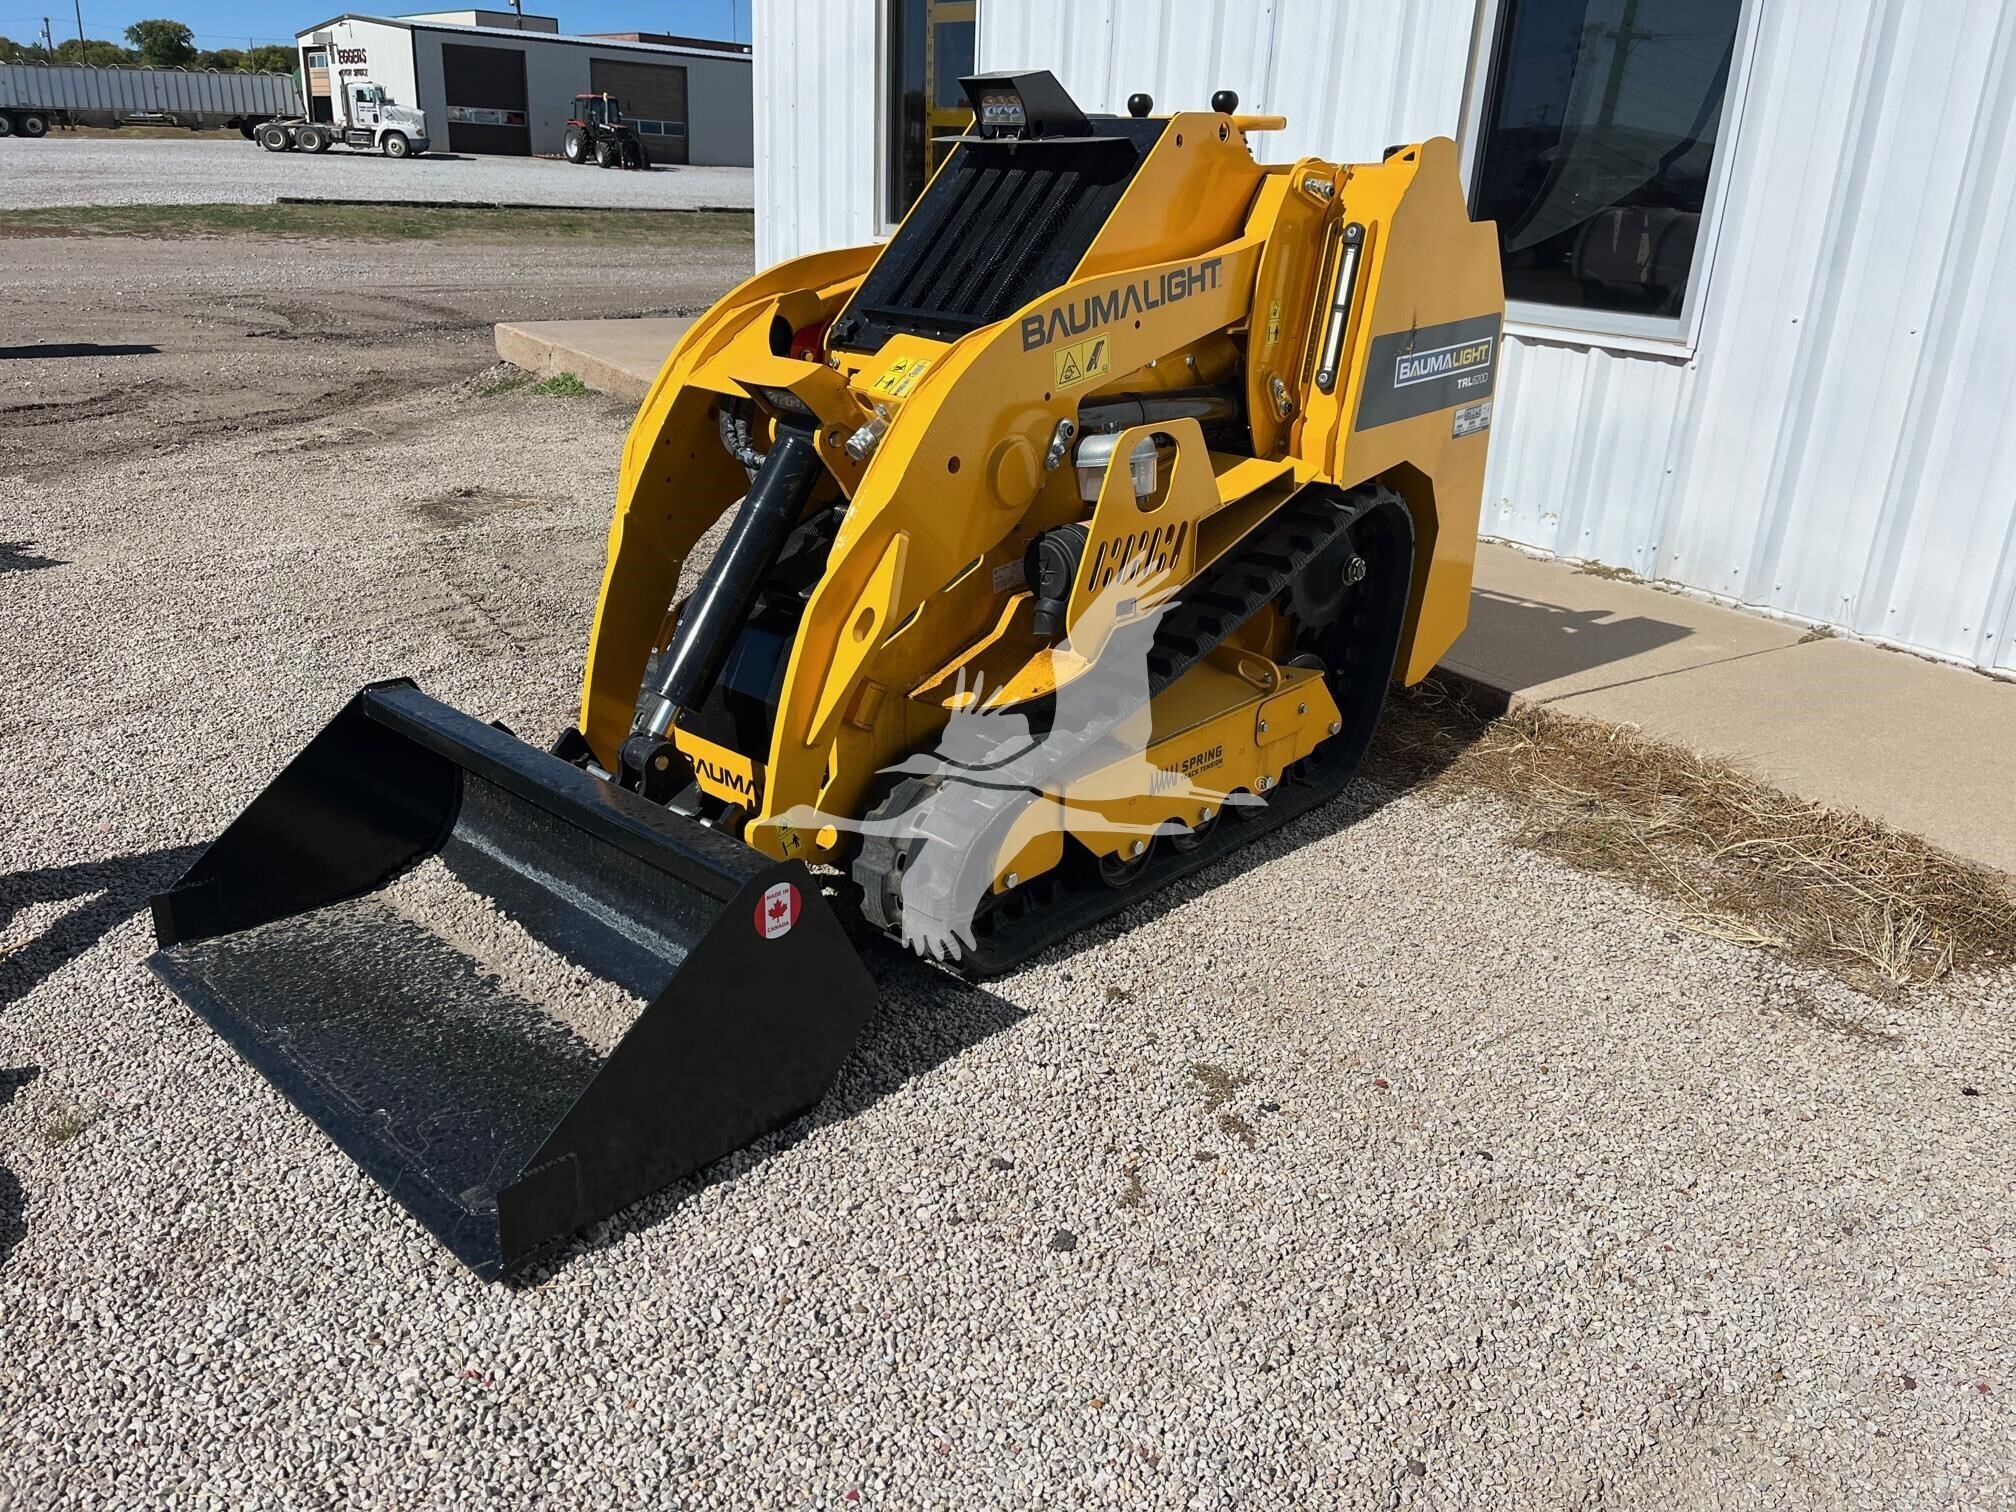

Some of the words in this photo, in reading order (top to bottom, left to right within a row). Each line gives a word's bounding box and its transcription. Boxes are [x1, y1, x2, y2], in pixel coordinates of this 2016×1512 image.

[338, 48, 367, 64] EGGERS
[1021, 257, 1223, 352] BAUMALIGHT
[1400, 344, 1489, 380] BAUMALIGHT
[1181, 745, 1223, 773] SPRING
[1200, 758, 1223, 773] TENSION
[766, 890, 782, 900] MADE
[767, 920, 790, 933] CANADA
